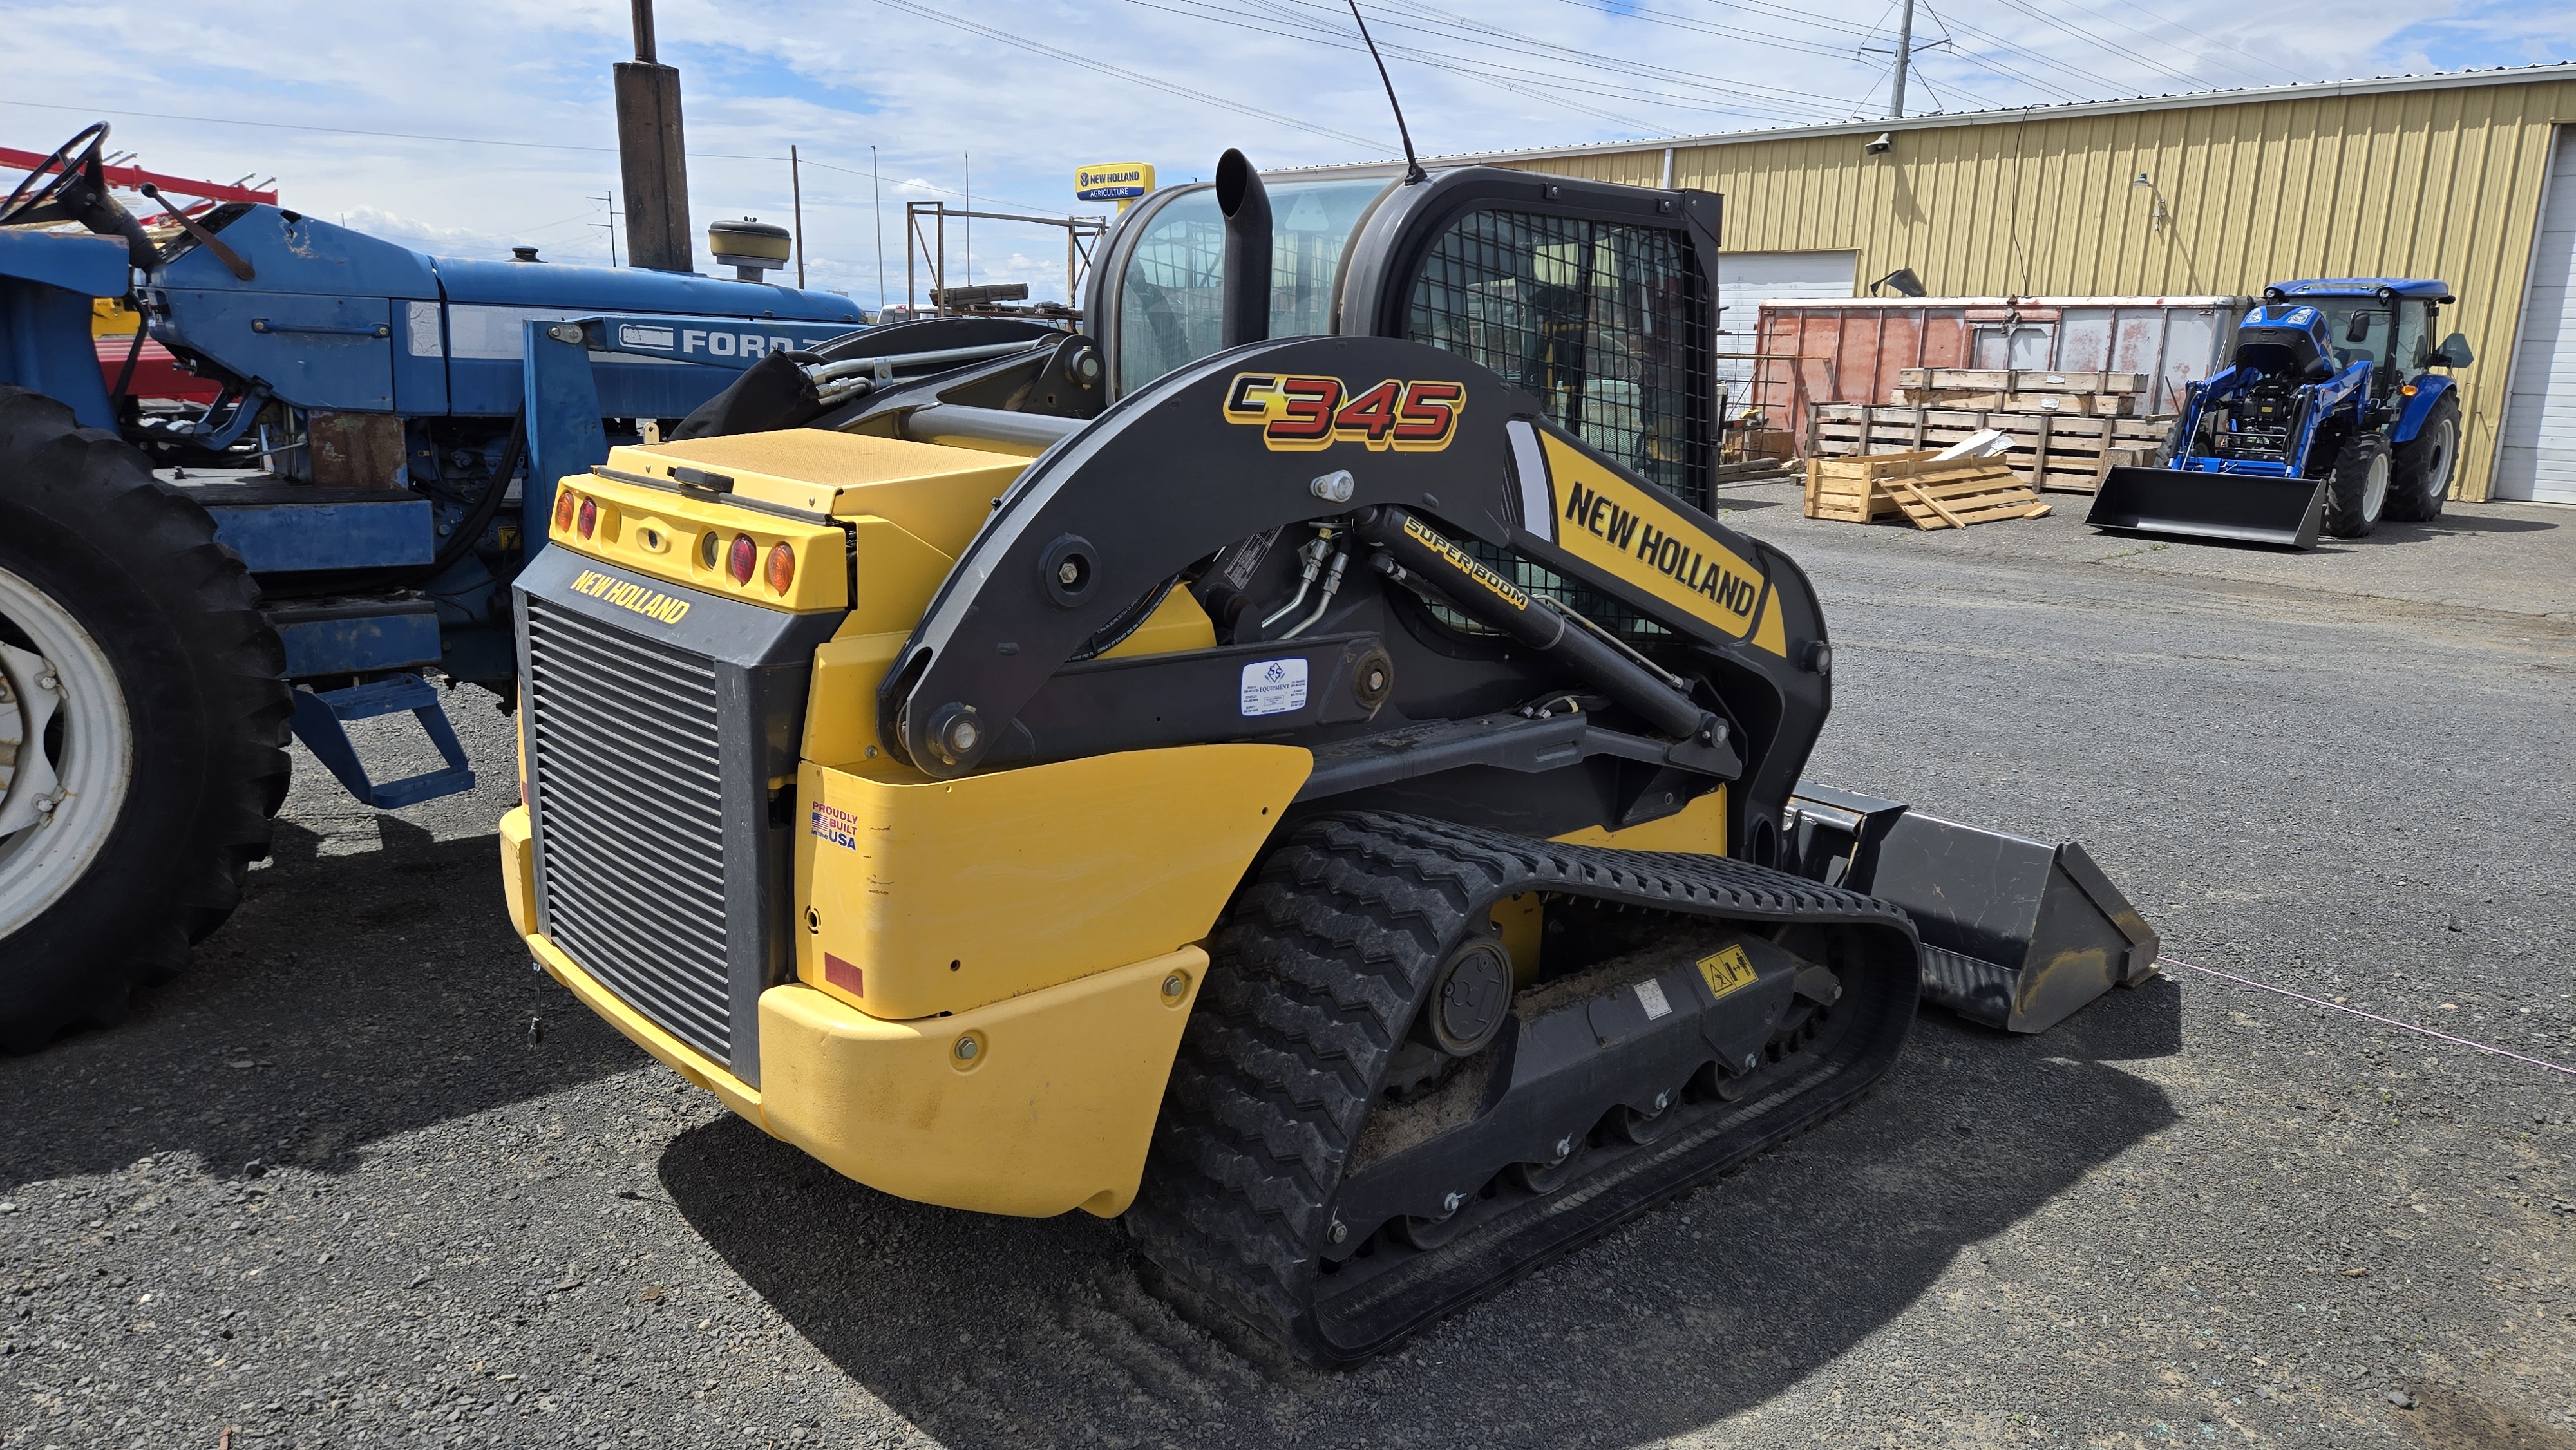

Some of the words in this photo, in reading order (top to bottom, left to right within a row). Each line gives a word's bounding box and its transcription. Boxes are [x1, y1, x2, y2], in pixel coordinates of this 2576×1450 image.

[1090, 174, 1106, 184] NEW
[1107, 171, 1140, 184] HOLLAND
[1090, 187, 1128, 198] AGRICULTURE
[683, 329, 793, 359] FORD
[1225, 373, 1465, 451] C345
[1565, 480, 1640, 552] NEW
[1636, 523, 1756, 618] HOLLAND
[1404, 516, 1473, 574] SUPER
[1472, 562, 1530, 611] BOOM
[570, 569, 612, 598] NEW
[603, 580, 690, 625] HOLLAND
[1162, 587, 1170, 598] MADE
[1259, 684, 1290, 693] EQUIPMENT
[812, 800, 858, 824] PROUDLY
[829, 818, 858, 835] BUILT
[818, 831, 828, 840] the
[829, 829, 856, 850] USA
